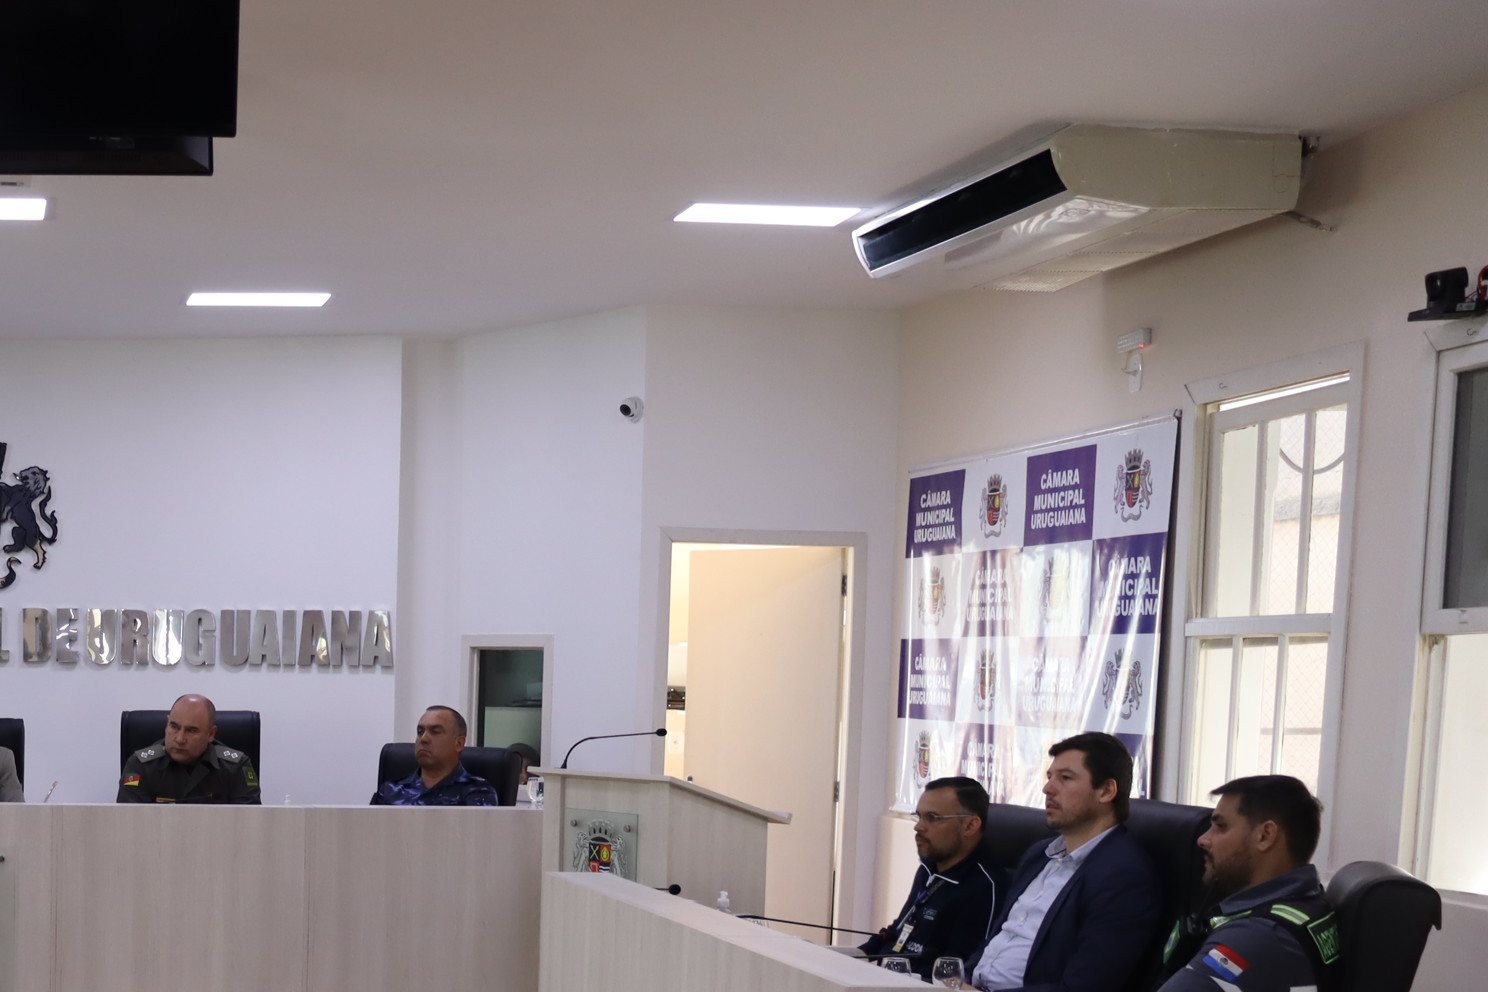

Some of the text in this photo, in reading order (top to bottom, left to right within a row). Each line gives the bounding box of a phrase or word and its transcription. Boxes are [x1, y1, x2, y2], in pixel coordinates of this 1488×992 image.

[1040, 468, 1080, 490] CÂMARA
[920, 490, 952, 508] CÂMARA
[1034, 488, 1085, 511] MUNICIPAL
[915, 508, 955, 527] MUNICIPAL
[1030, 506, 1086, 530] URUGUAIANA
[914, 524, 956, 544] URUGUAIANA
[22, 607, 80, 664] DE
[87, 608, 394, 668] URUGUAIANA
